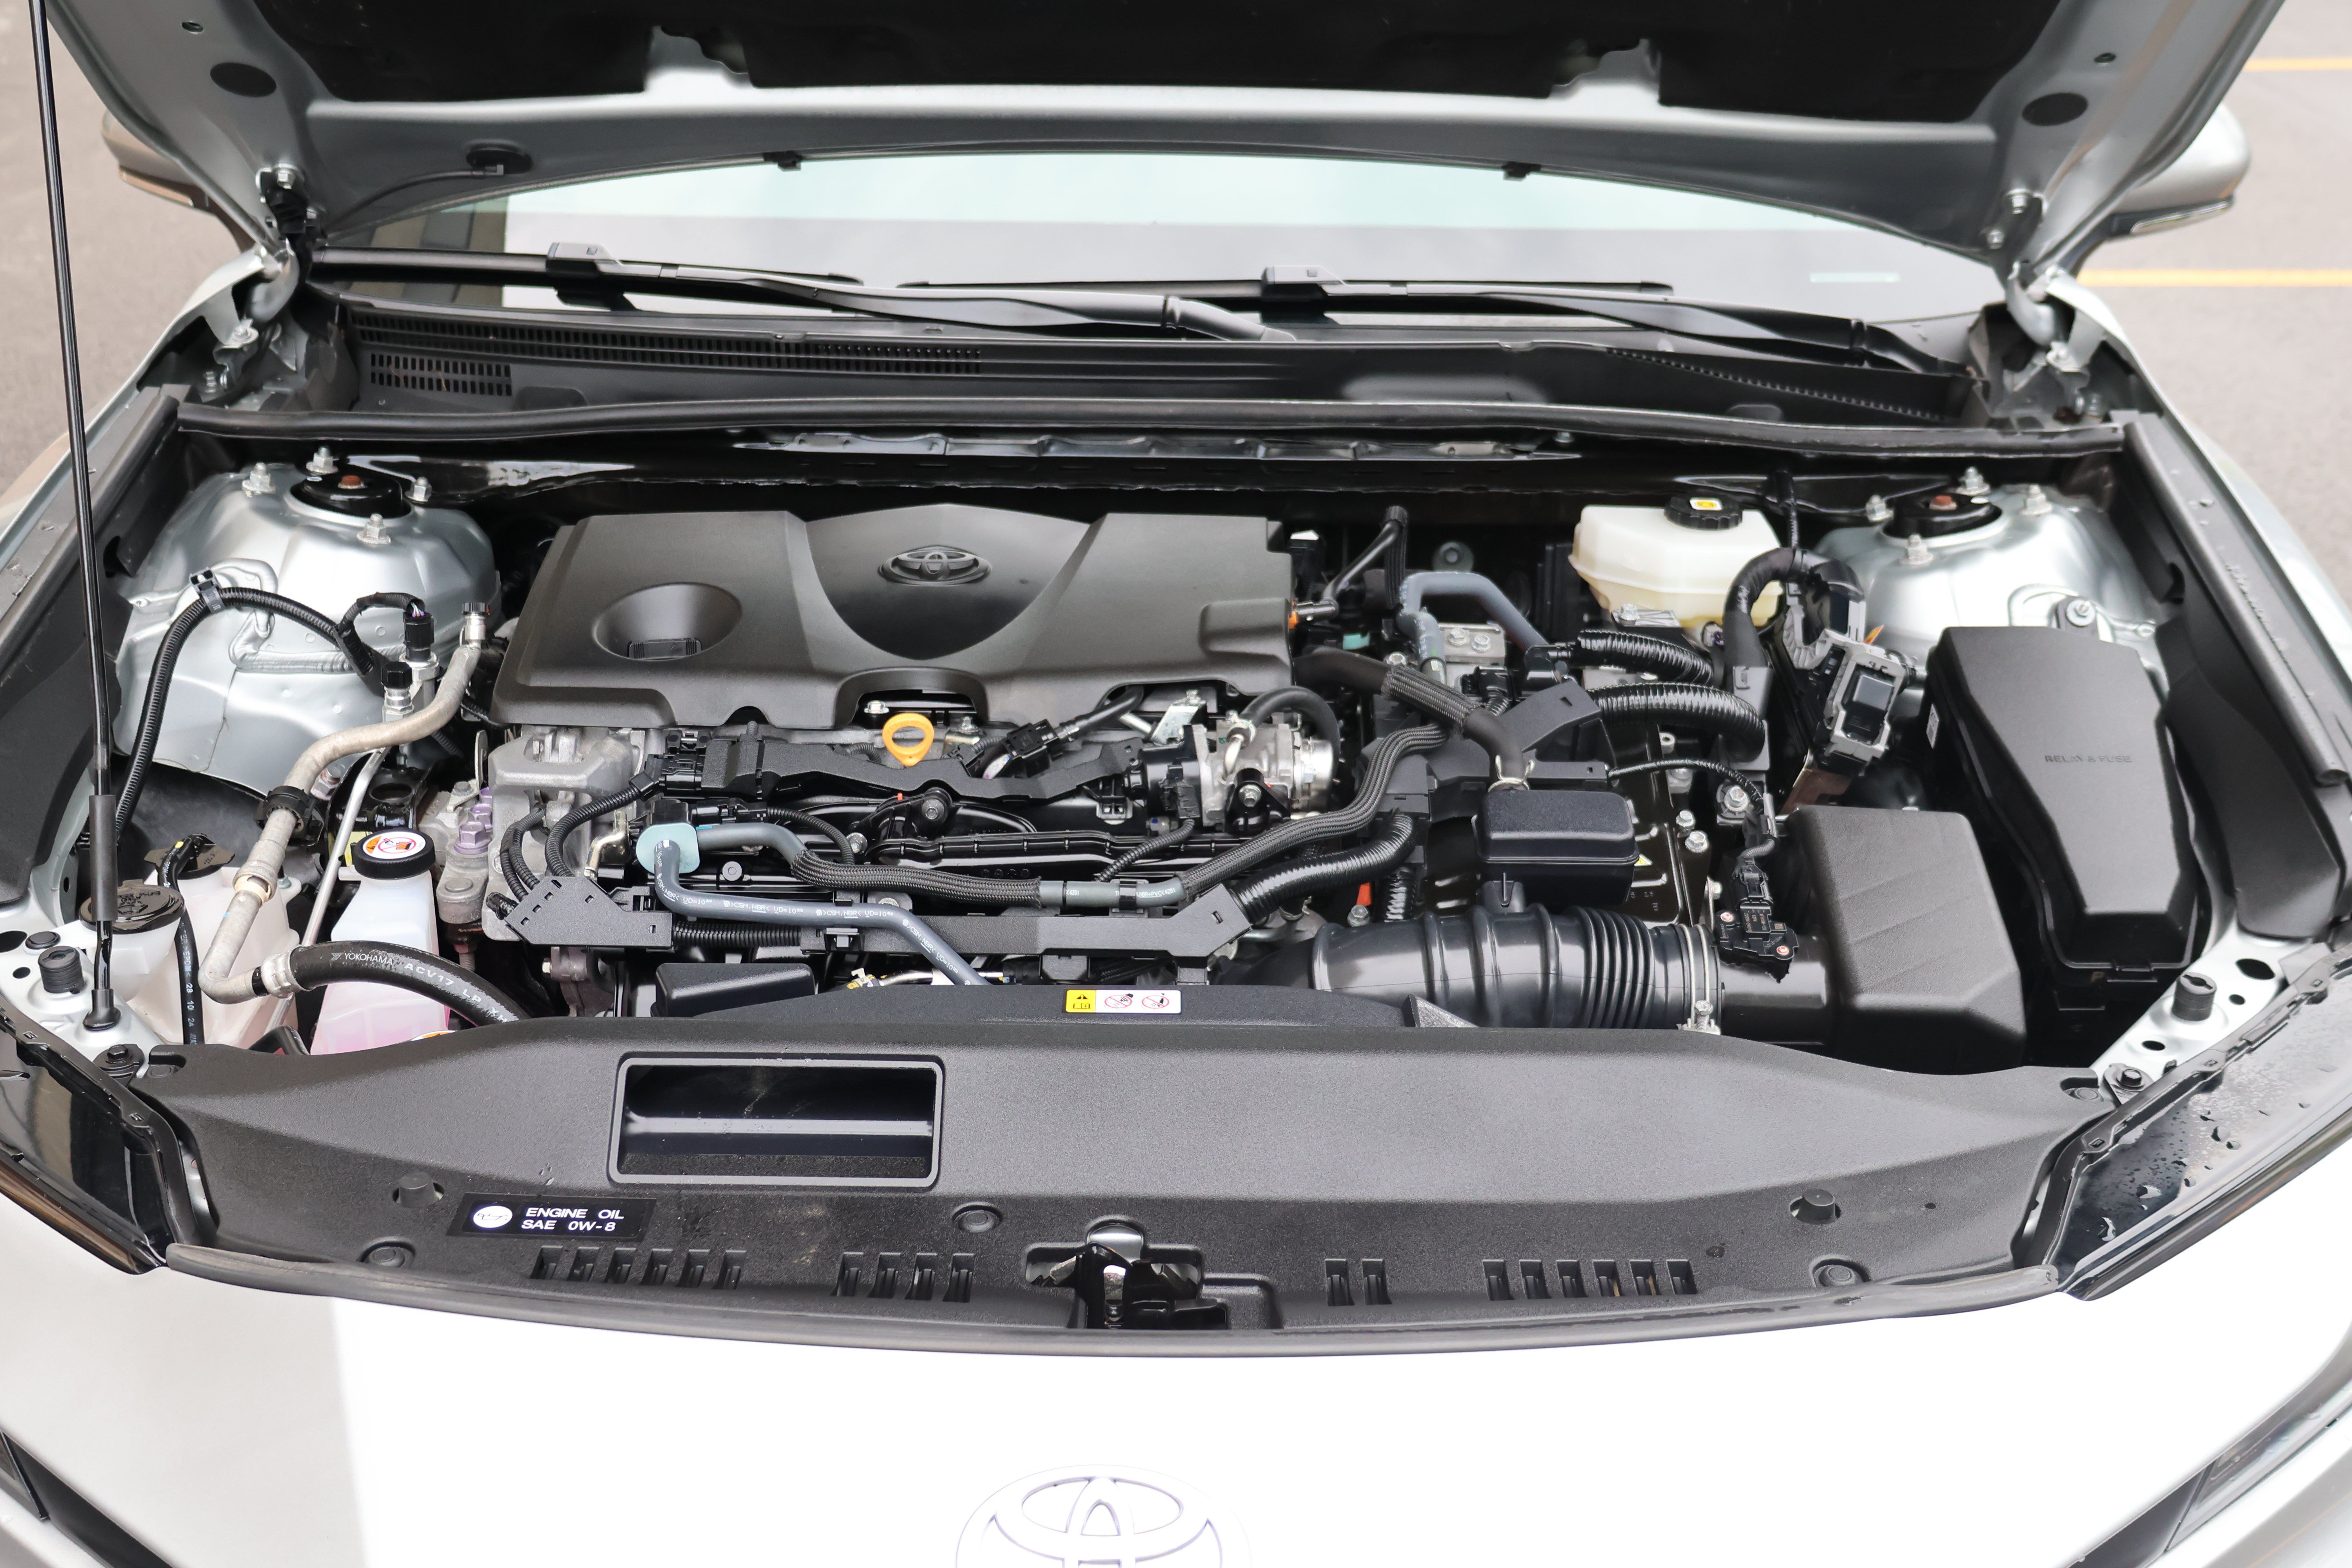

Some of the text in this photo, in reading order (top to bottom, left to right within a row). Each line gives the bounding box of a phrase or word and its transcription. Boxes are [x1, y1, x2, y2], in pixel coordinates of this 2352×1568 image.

[344, 953, 392, 965] YOKOHAMA
[404, 963, 454, 986] ACV17
[526, 1207, 625, 1219] ENGINE OIL
[521, 1220, 616, 1232] SAE 0W-8
